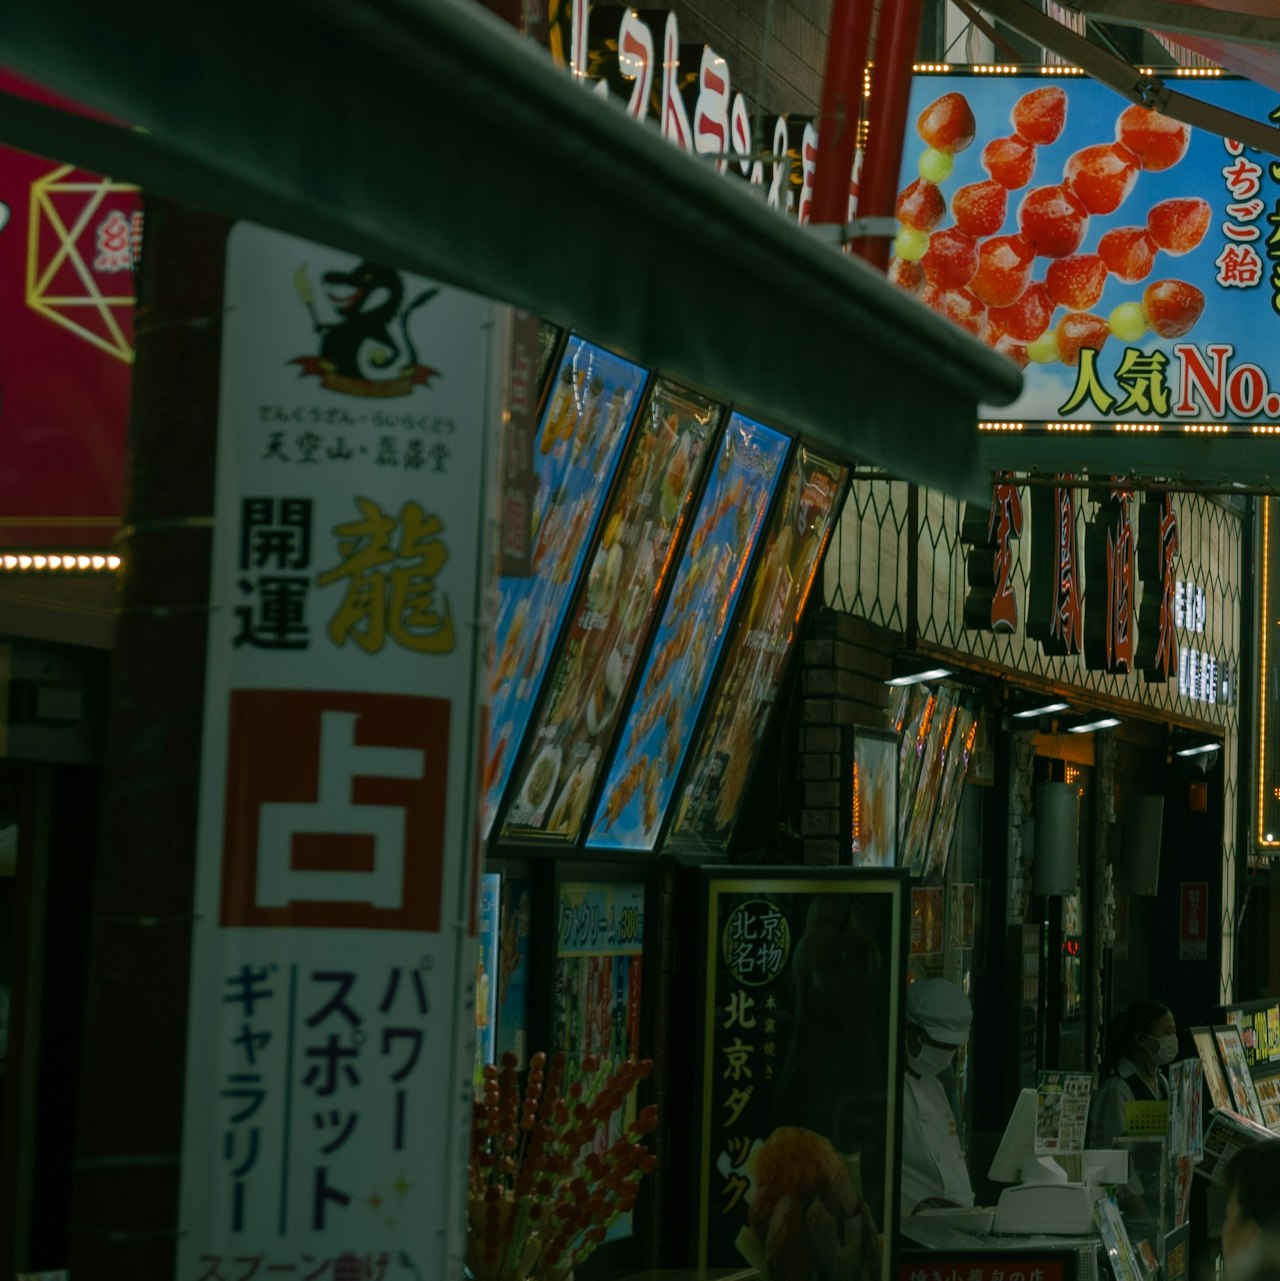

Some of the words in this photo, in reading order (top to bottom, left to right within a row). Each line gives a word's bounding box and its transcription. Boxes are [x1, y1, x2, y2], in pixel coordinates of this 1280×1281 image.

[233, 497, 312, 651] 開運
[316, 495, 456, 655] 龍
[254, 710, 427, 910] 占
[220, 964, 280, 1232] ギャラリー
[303, 971, 367, 1231] スポット
[380, 954, 433, 1151] パワー
[722, 989, 758, 1216] 北京ダック
